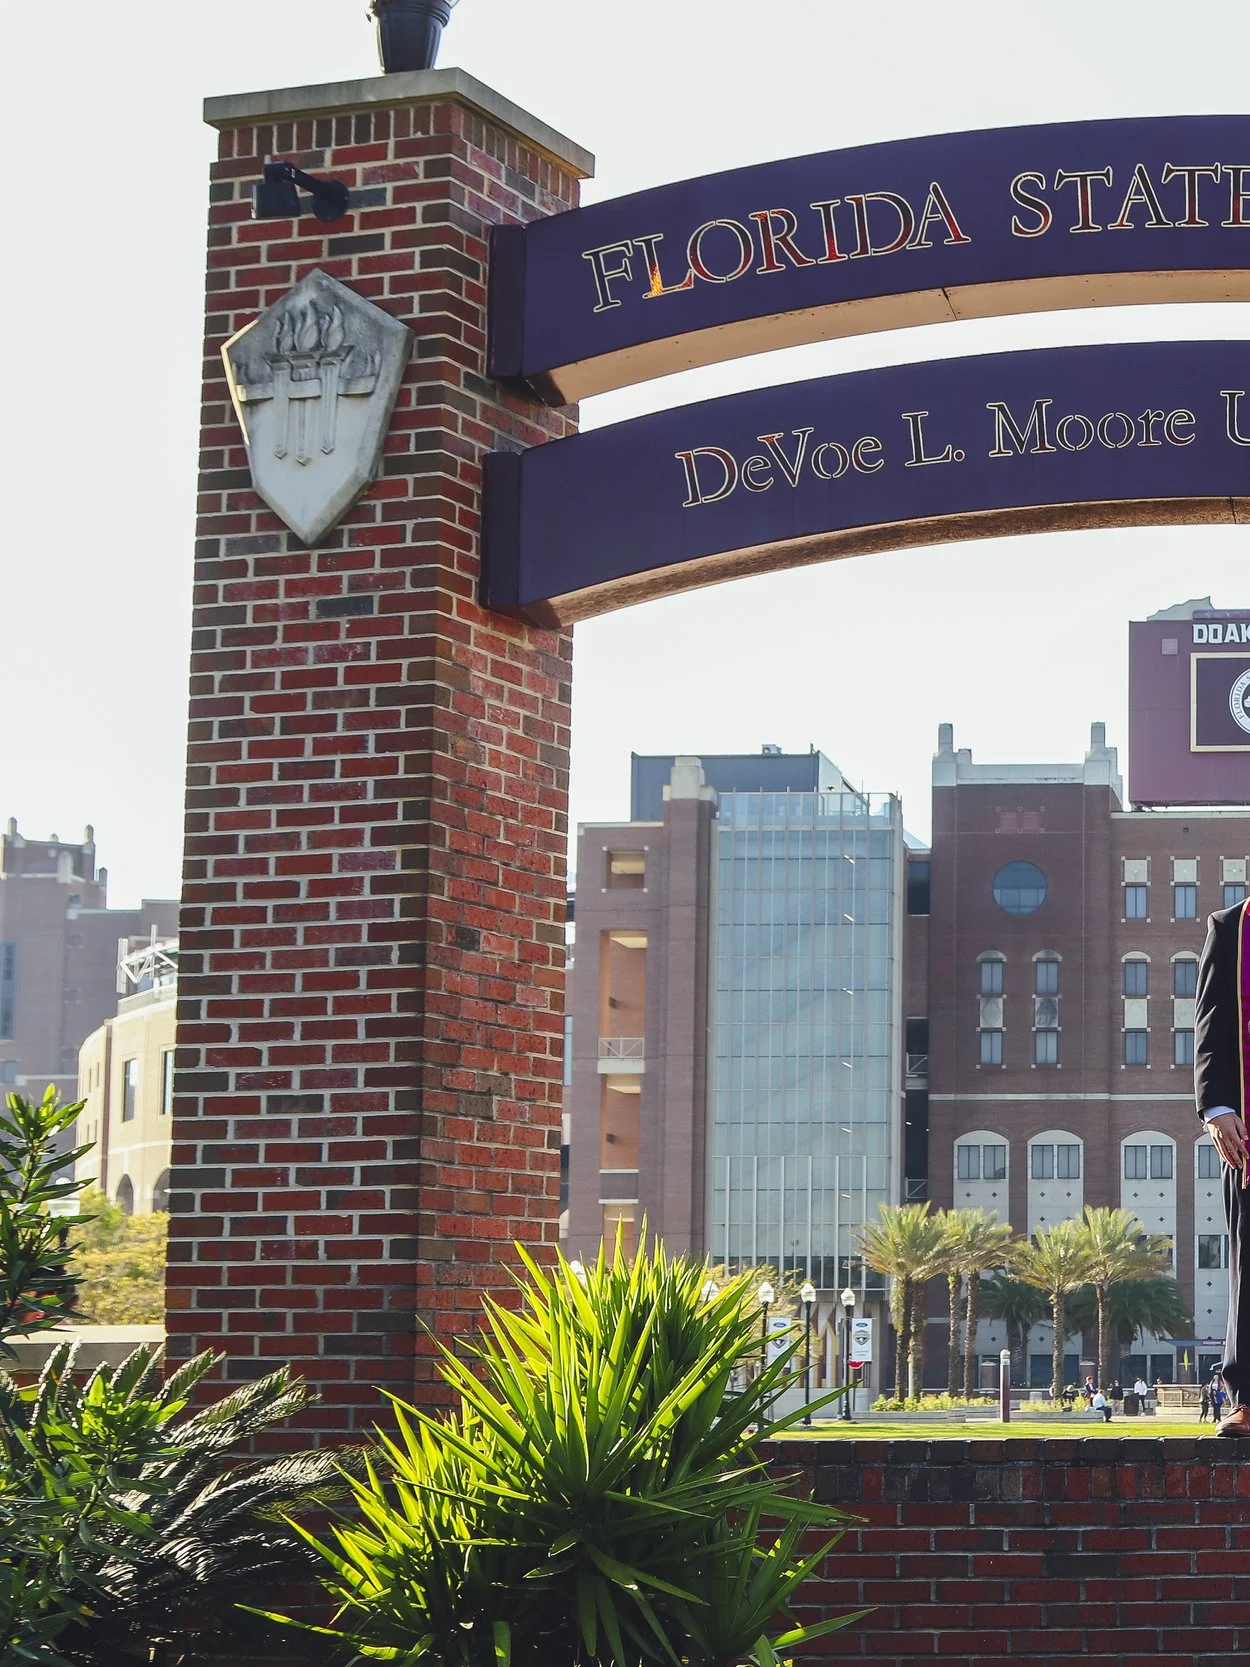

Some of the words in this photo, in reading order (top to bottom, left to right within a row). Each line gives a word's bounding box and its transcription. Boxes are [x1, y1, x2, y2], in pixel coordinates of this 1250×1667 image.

[582, 181, 972, 313] FLORIDA
[675, 426, 885, 508] DeVoe
[901, 410, 966, 469] L.
[986, 398, 1197, 458] Moore
[1234, 681, 1246, 719] FLORIDA
